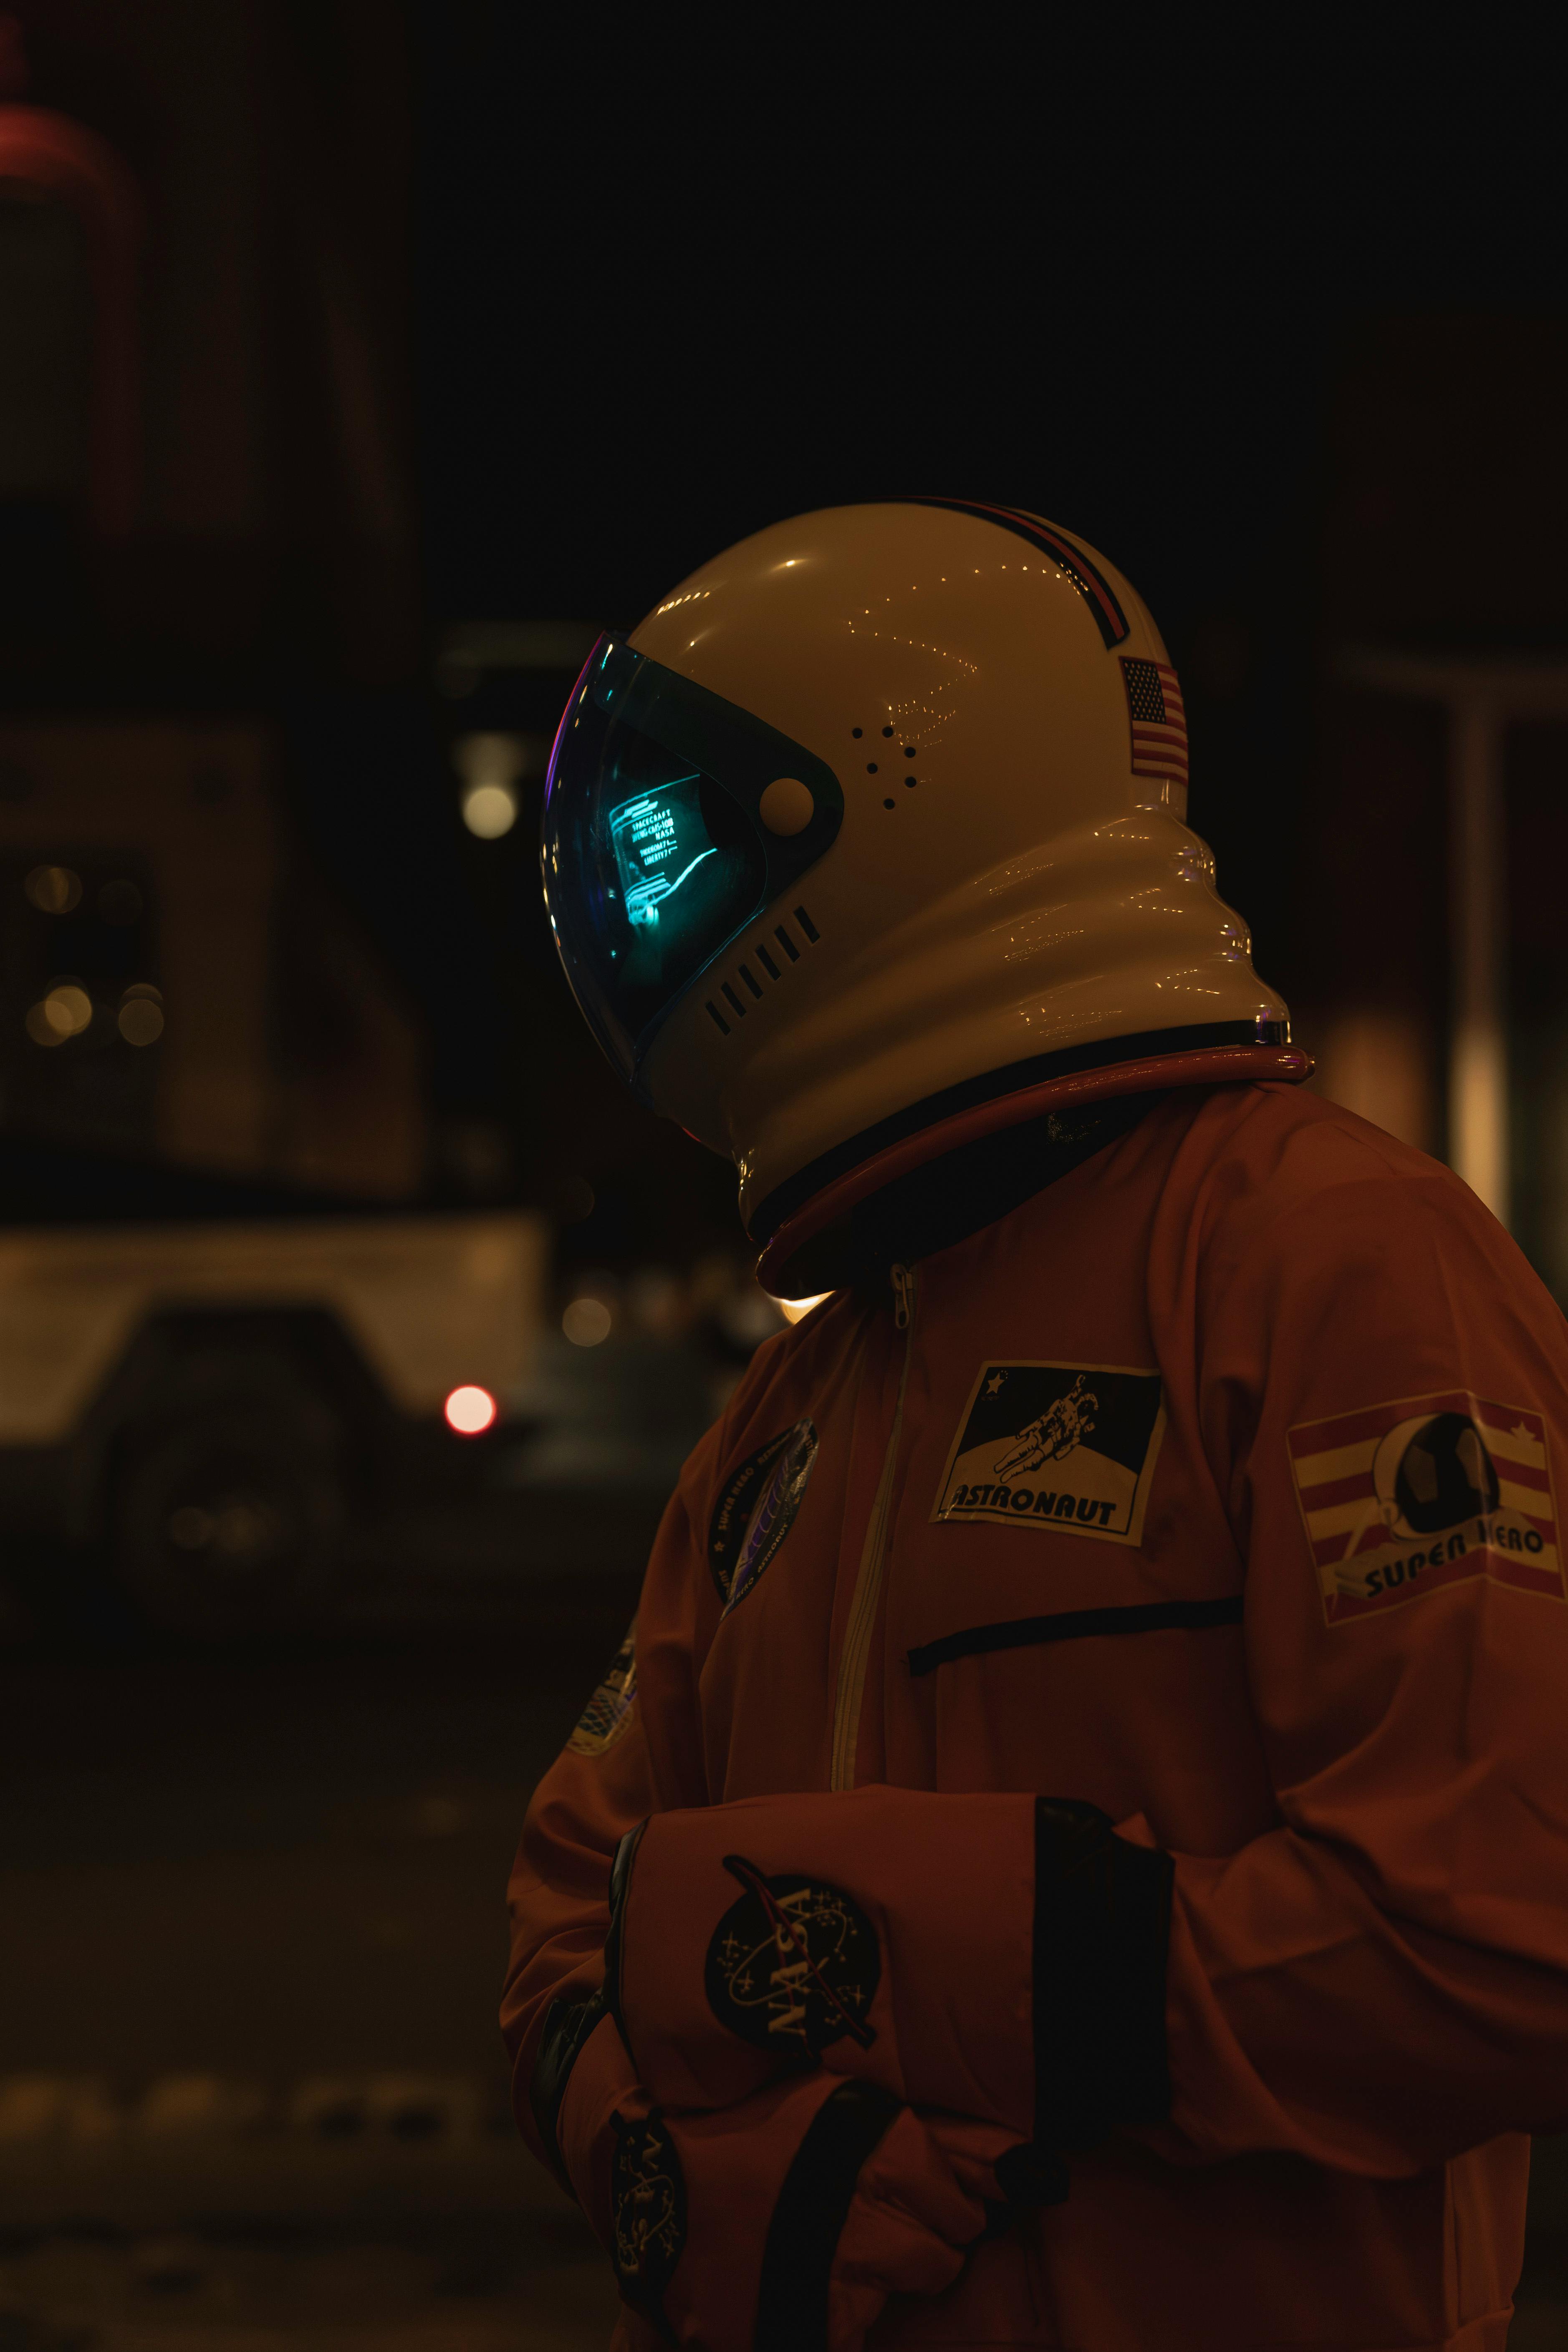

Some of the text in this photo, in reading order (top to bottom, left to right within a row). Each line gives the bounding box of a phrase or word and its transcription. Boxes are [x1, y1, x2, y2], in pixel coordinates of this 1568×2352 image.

[632, 809, 671, 831] SPACECRAFT
[655, 827, 674, 840] NASA
[718, 1466, 755, 1531] SUPER HERO
[952, 1484, 1116, 1526] ASTRONAUT
[1365, 1519, 1543, 1597] SUPER HERO
[767, 1887, 812, 2035] NASA
